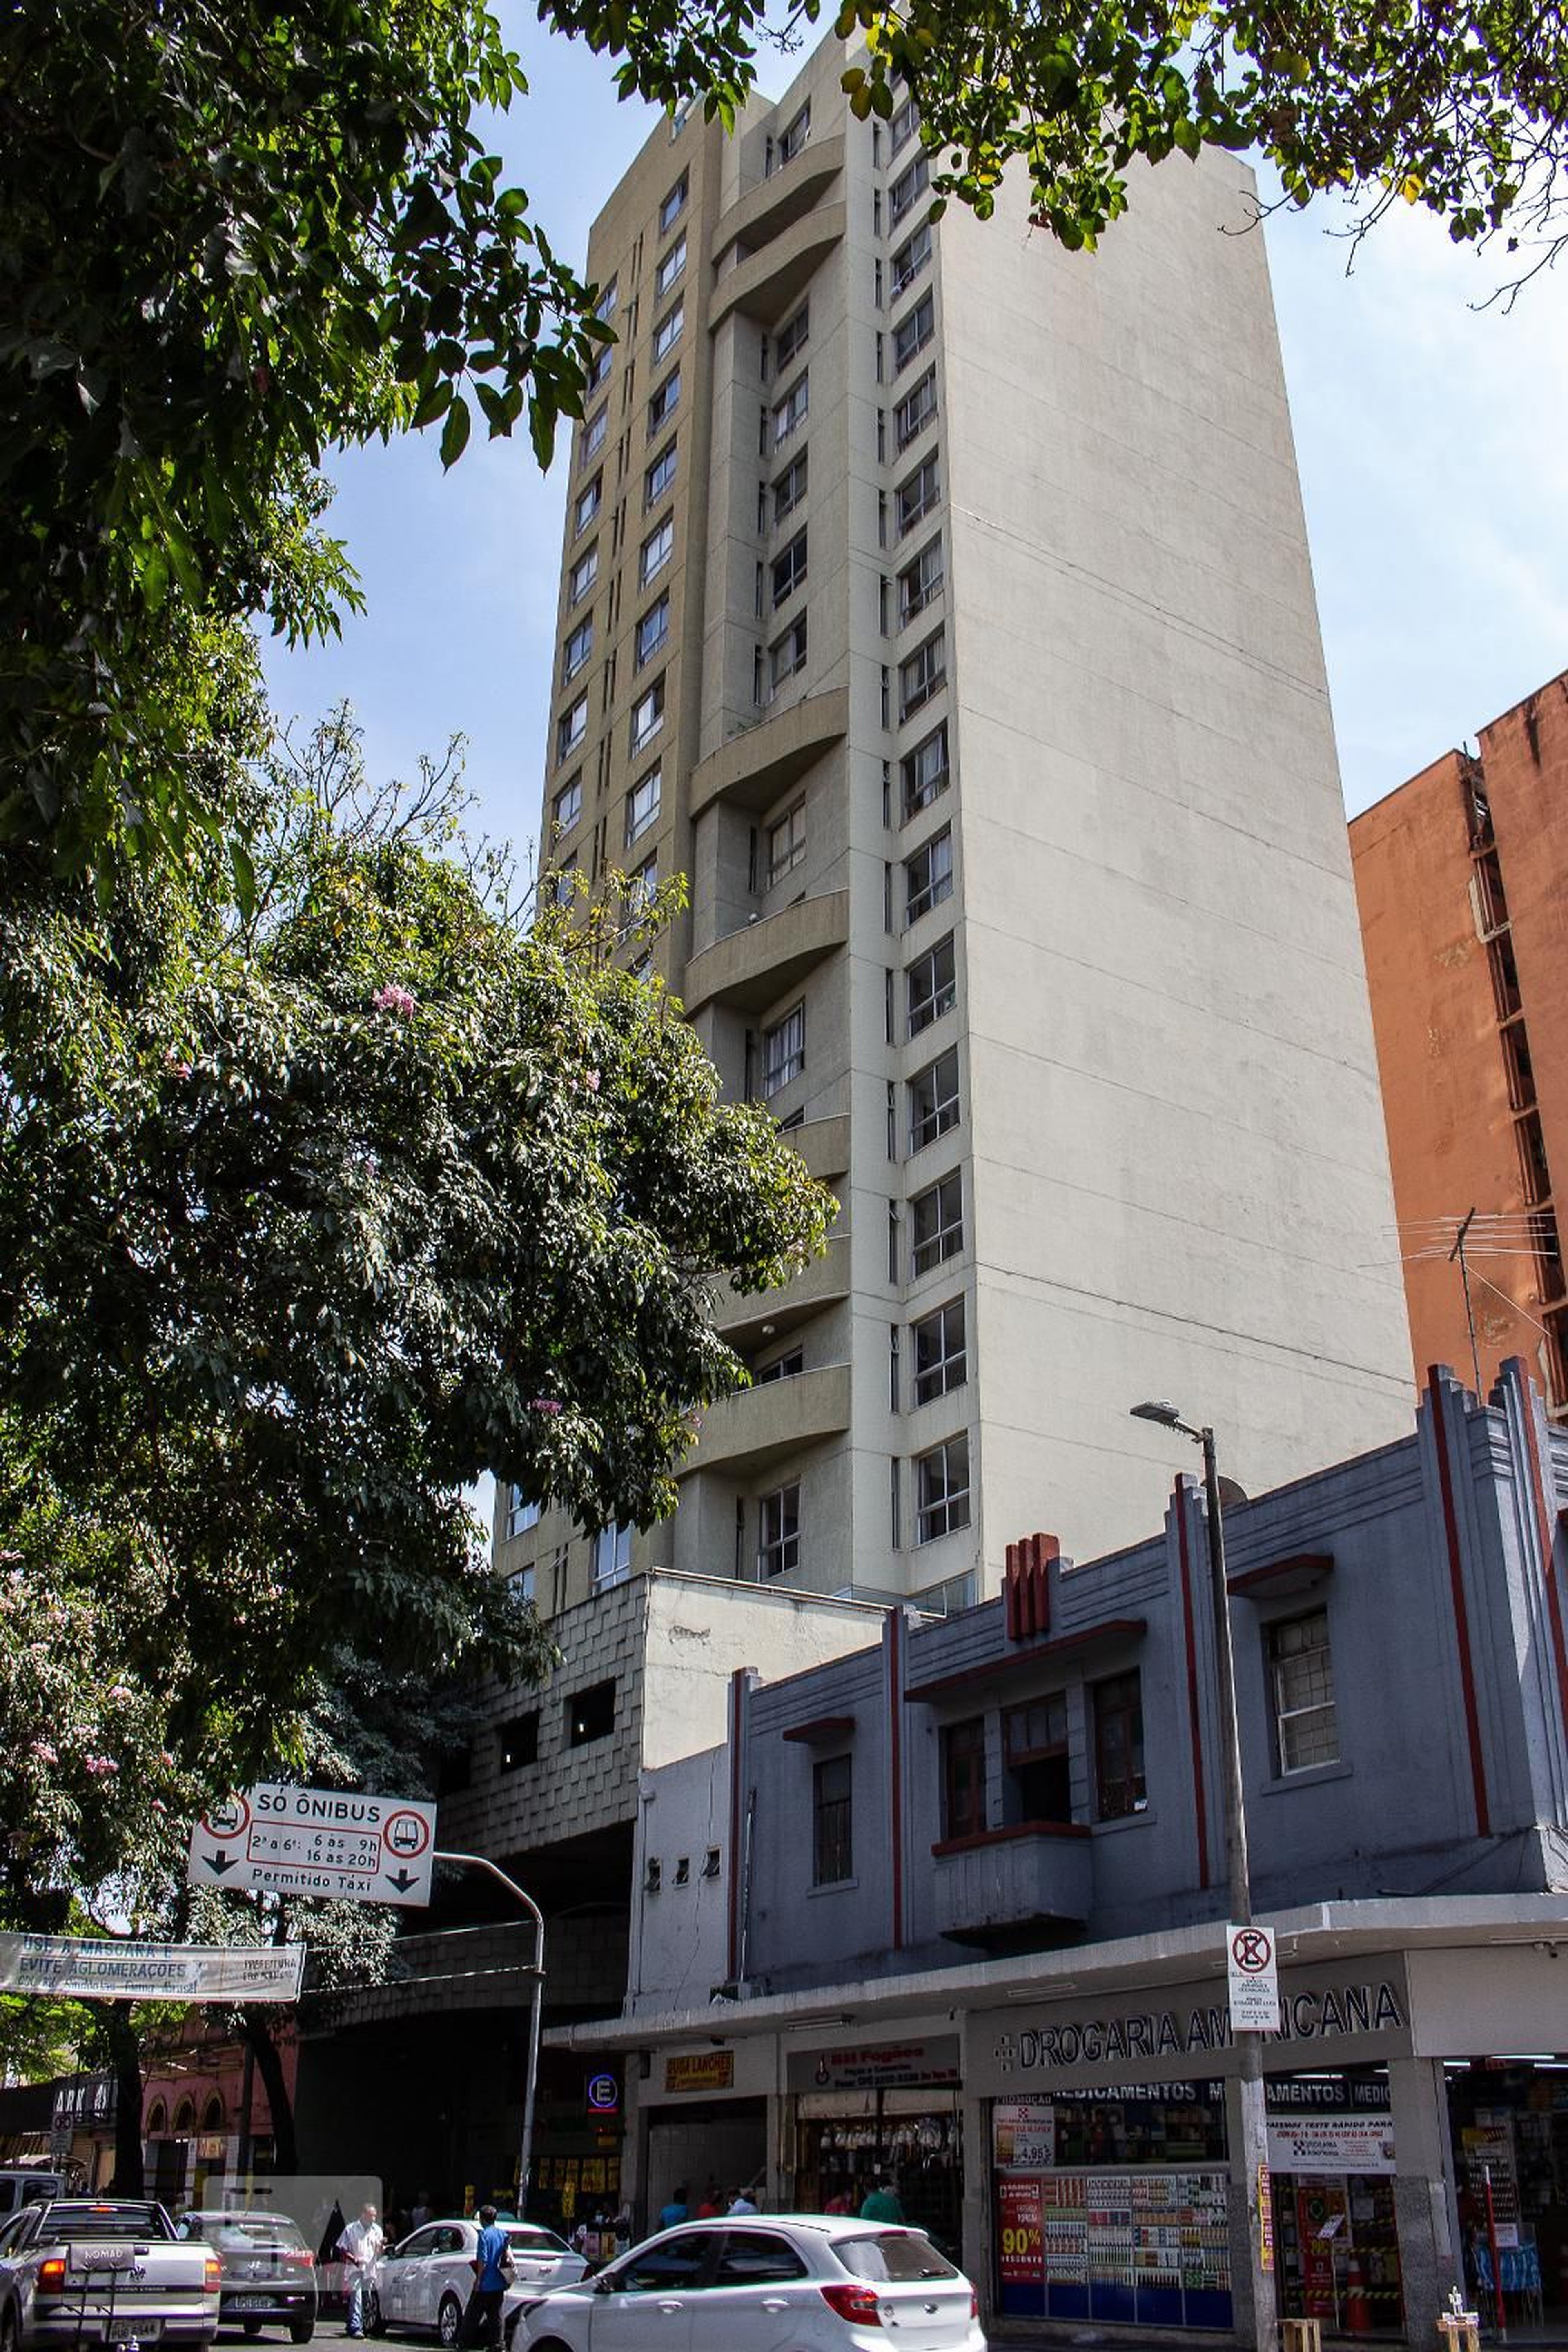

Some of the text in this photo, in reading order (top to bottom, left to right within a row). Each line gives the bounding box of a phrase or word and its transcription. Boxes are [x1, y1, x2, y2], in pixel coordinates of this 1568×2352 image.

[257, 1787, 380, 1822] SÓ ÔNIBUS
[315, 1835, 322, 1846] 6
[328, 1833, 344, 1848] às
[359, 1840, 377, 1851] 9h
[307, 1849, 321, 1861] 16
[348, 1853, 376, 1867] 20h
[252, 1868, 371, 1891] Permitido Táxi
[24, 1936, 53, 1952] USE
[21, 1957, 62, 1973] EVITE
[1020, 1982, 1402, 2069] DROGARIA AMICANA
[597, 2081, 612, 2101] E
[85, 2250, 123, 2259] NOMAD
